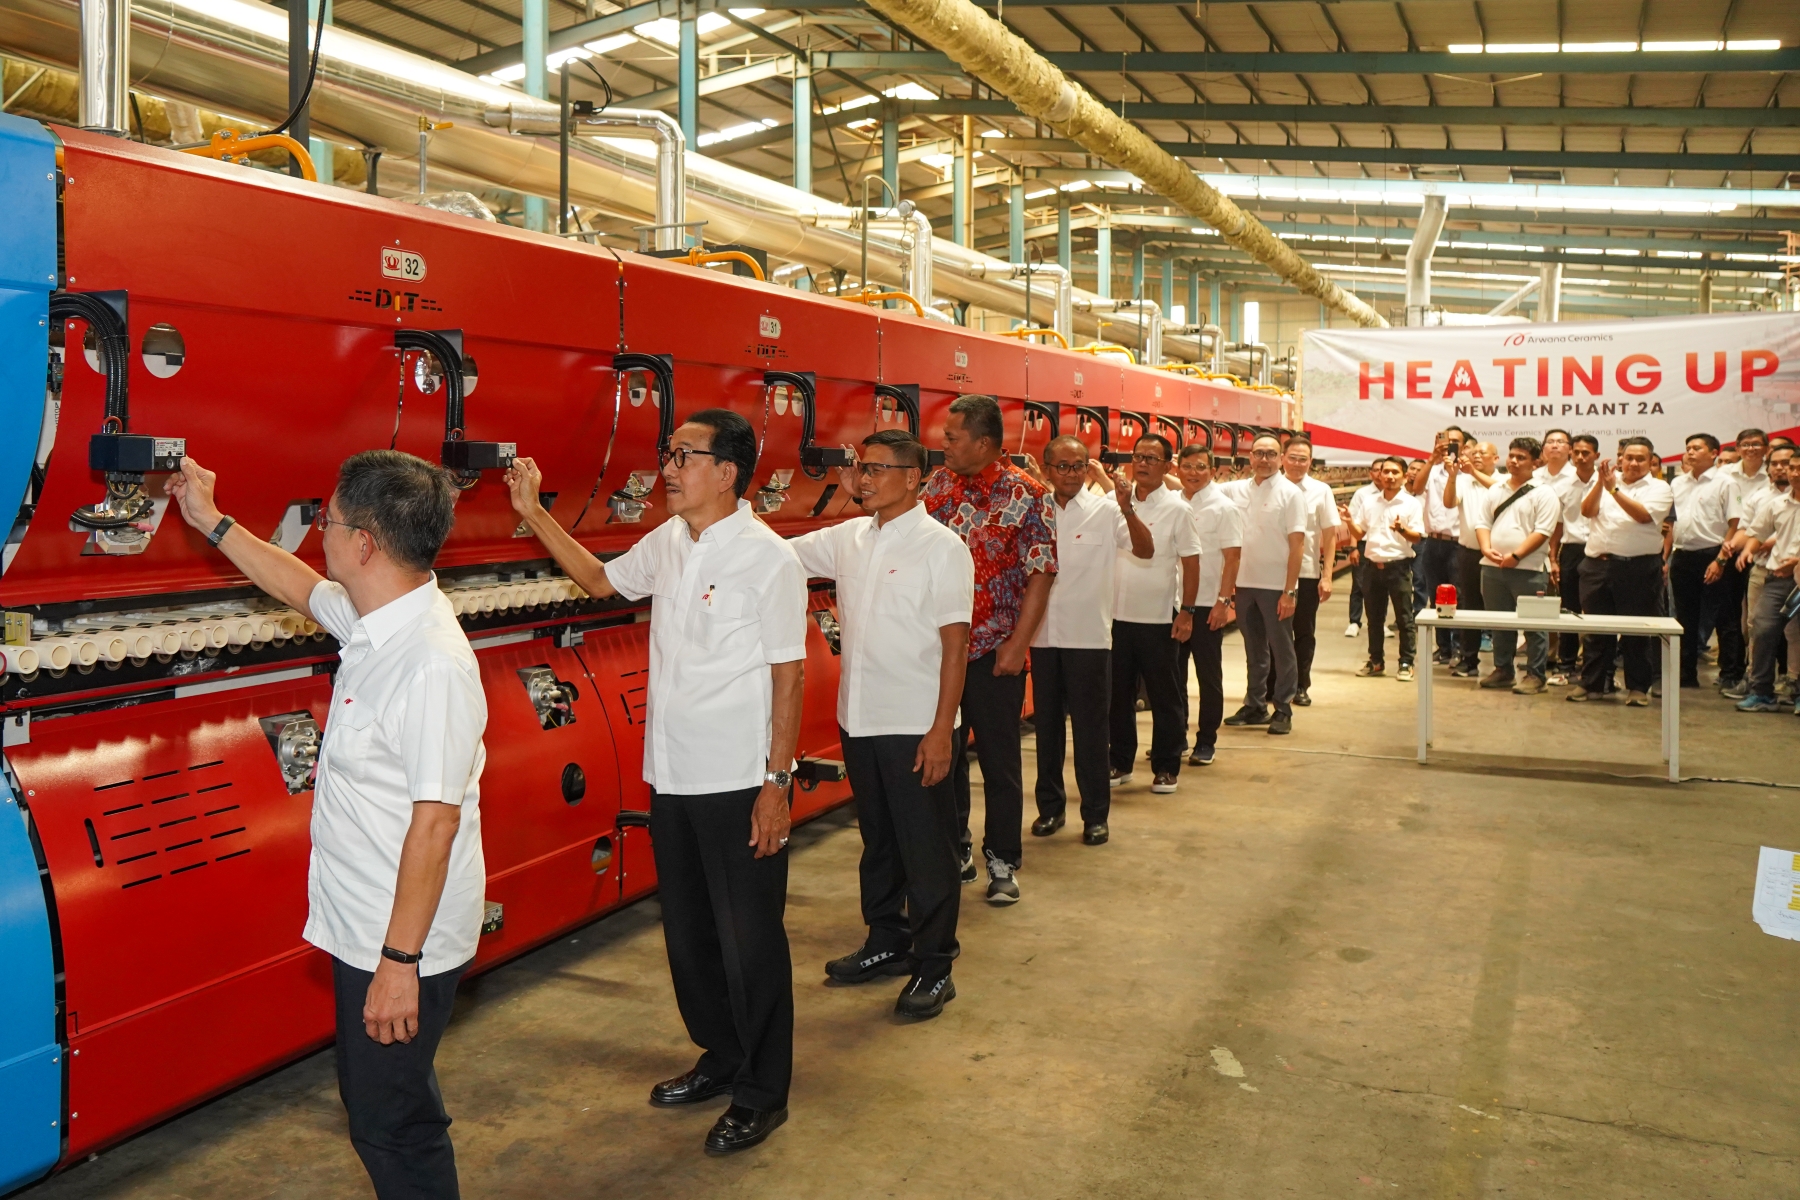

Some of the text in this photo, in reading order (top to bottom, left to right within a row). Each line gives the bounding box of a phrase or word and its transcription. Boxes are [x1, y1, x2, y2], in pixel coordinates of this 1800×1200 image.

[404, 257, 420, 276] 32
[770, 321, 778, 334] 31
[1527, 333, 1614, 344] Arwana Ceramics
[1358, 349, 1780, 400] HEATING UP
[1455, 401, 1665, 417] NEW KILN PLANT 2A
[1472, 429, 1502, 437] Arwana
[1504, 429, 1542, 437] Ceramics
[1581, 429, 1614, 437] Serang,
[1616, 428, 1647, 436] Banten
